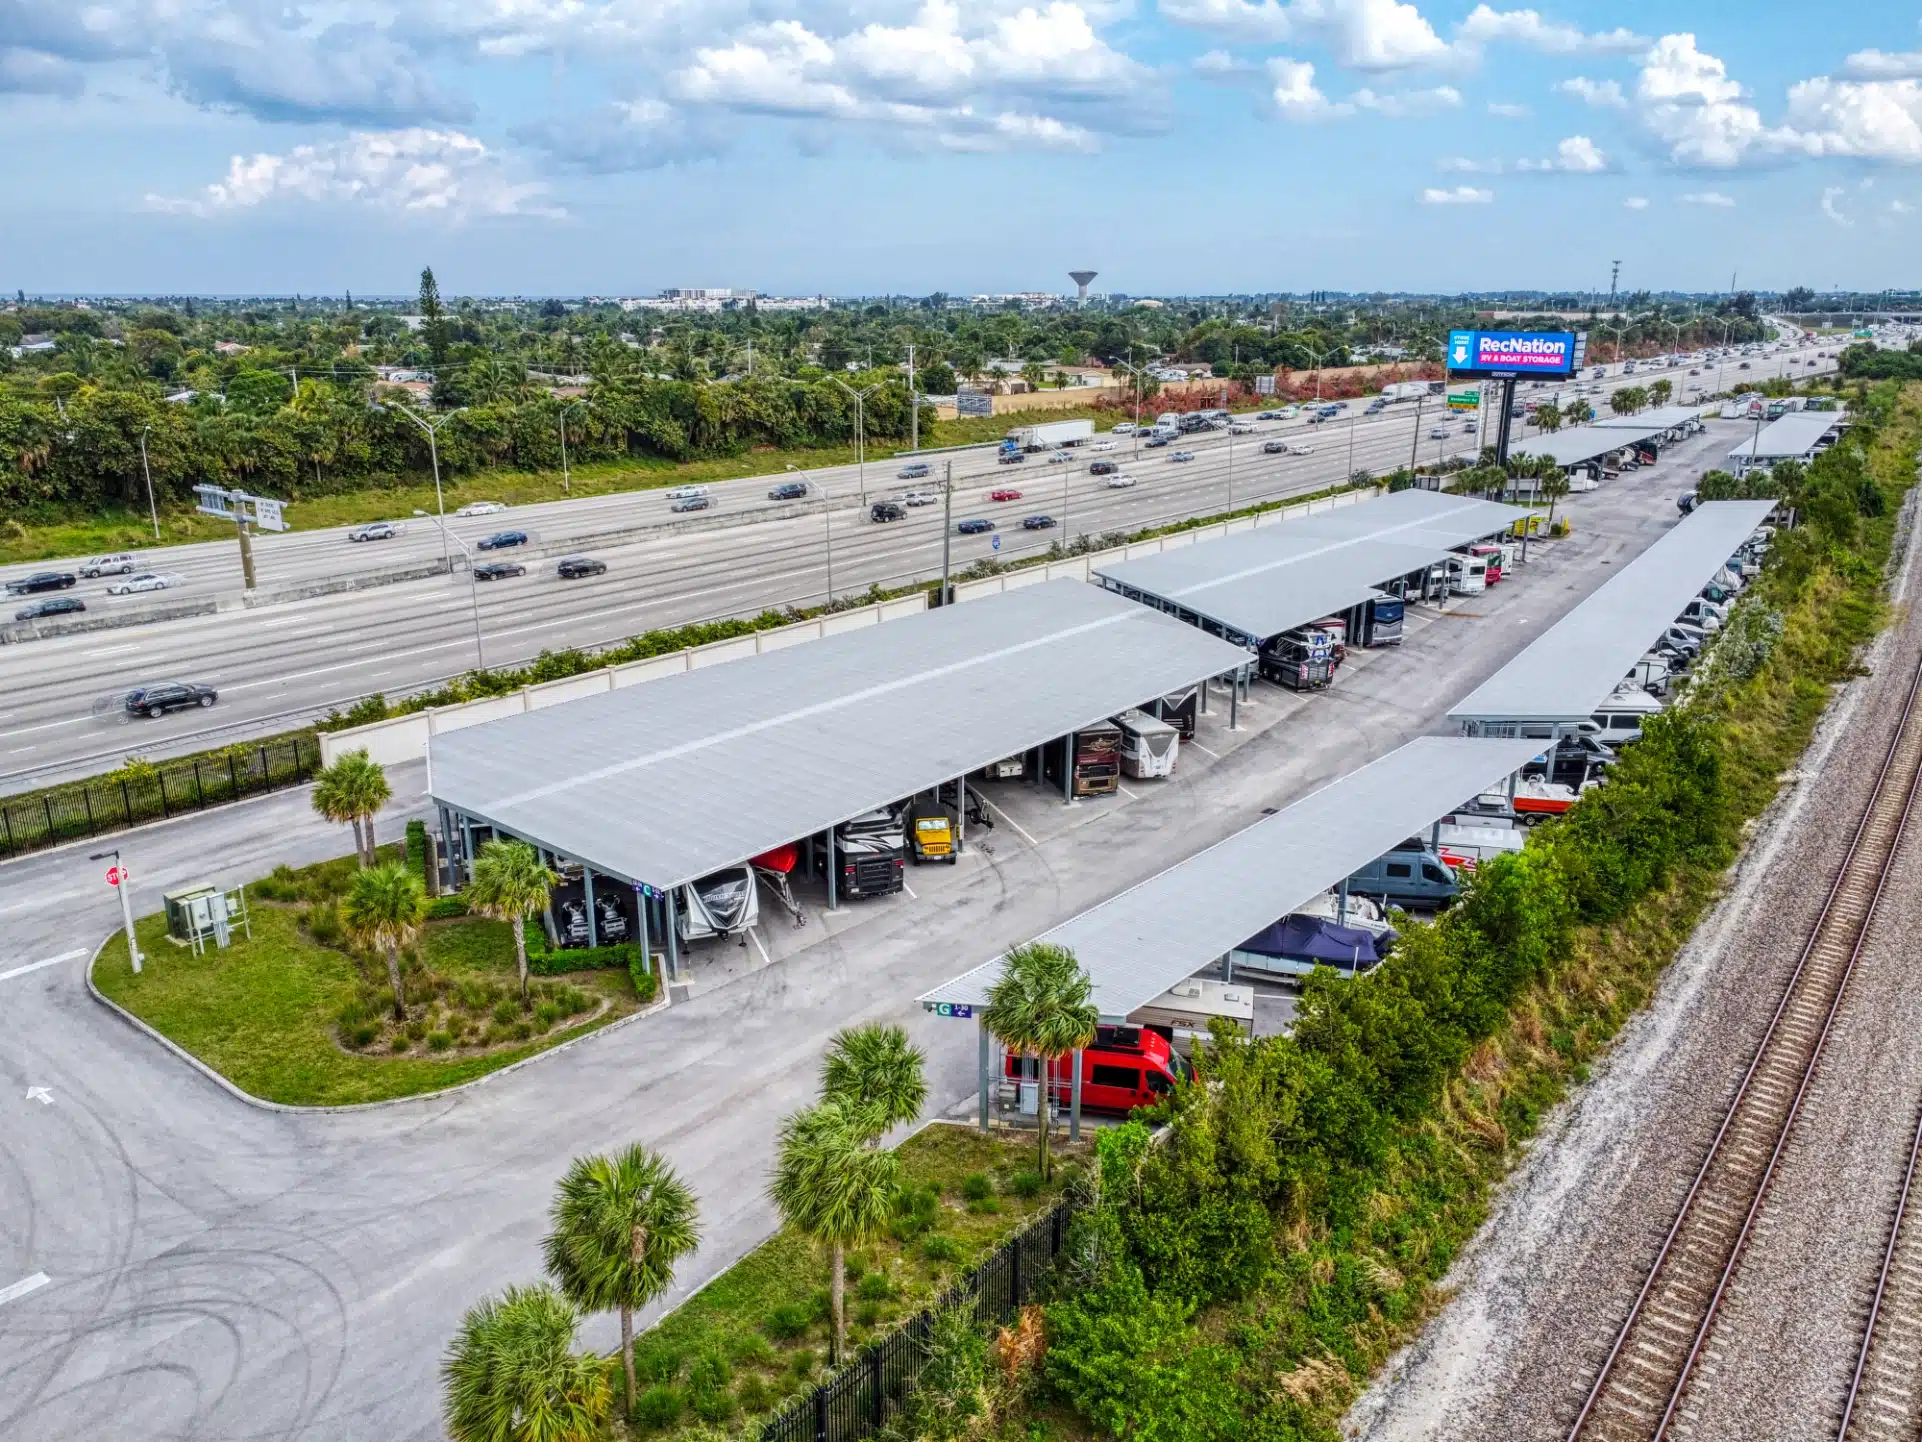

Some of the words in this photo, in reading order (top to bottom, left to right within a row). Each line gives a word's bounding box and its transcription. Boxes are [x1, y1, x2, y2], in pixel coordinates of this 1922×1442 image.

[1480, 337, 1565, 354] RecNation
[1481, 354, 1492, 362] RV
[1523, 355, 1561, 364] STORAGE
[939, 1003, 950, 1015] G
